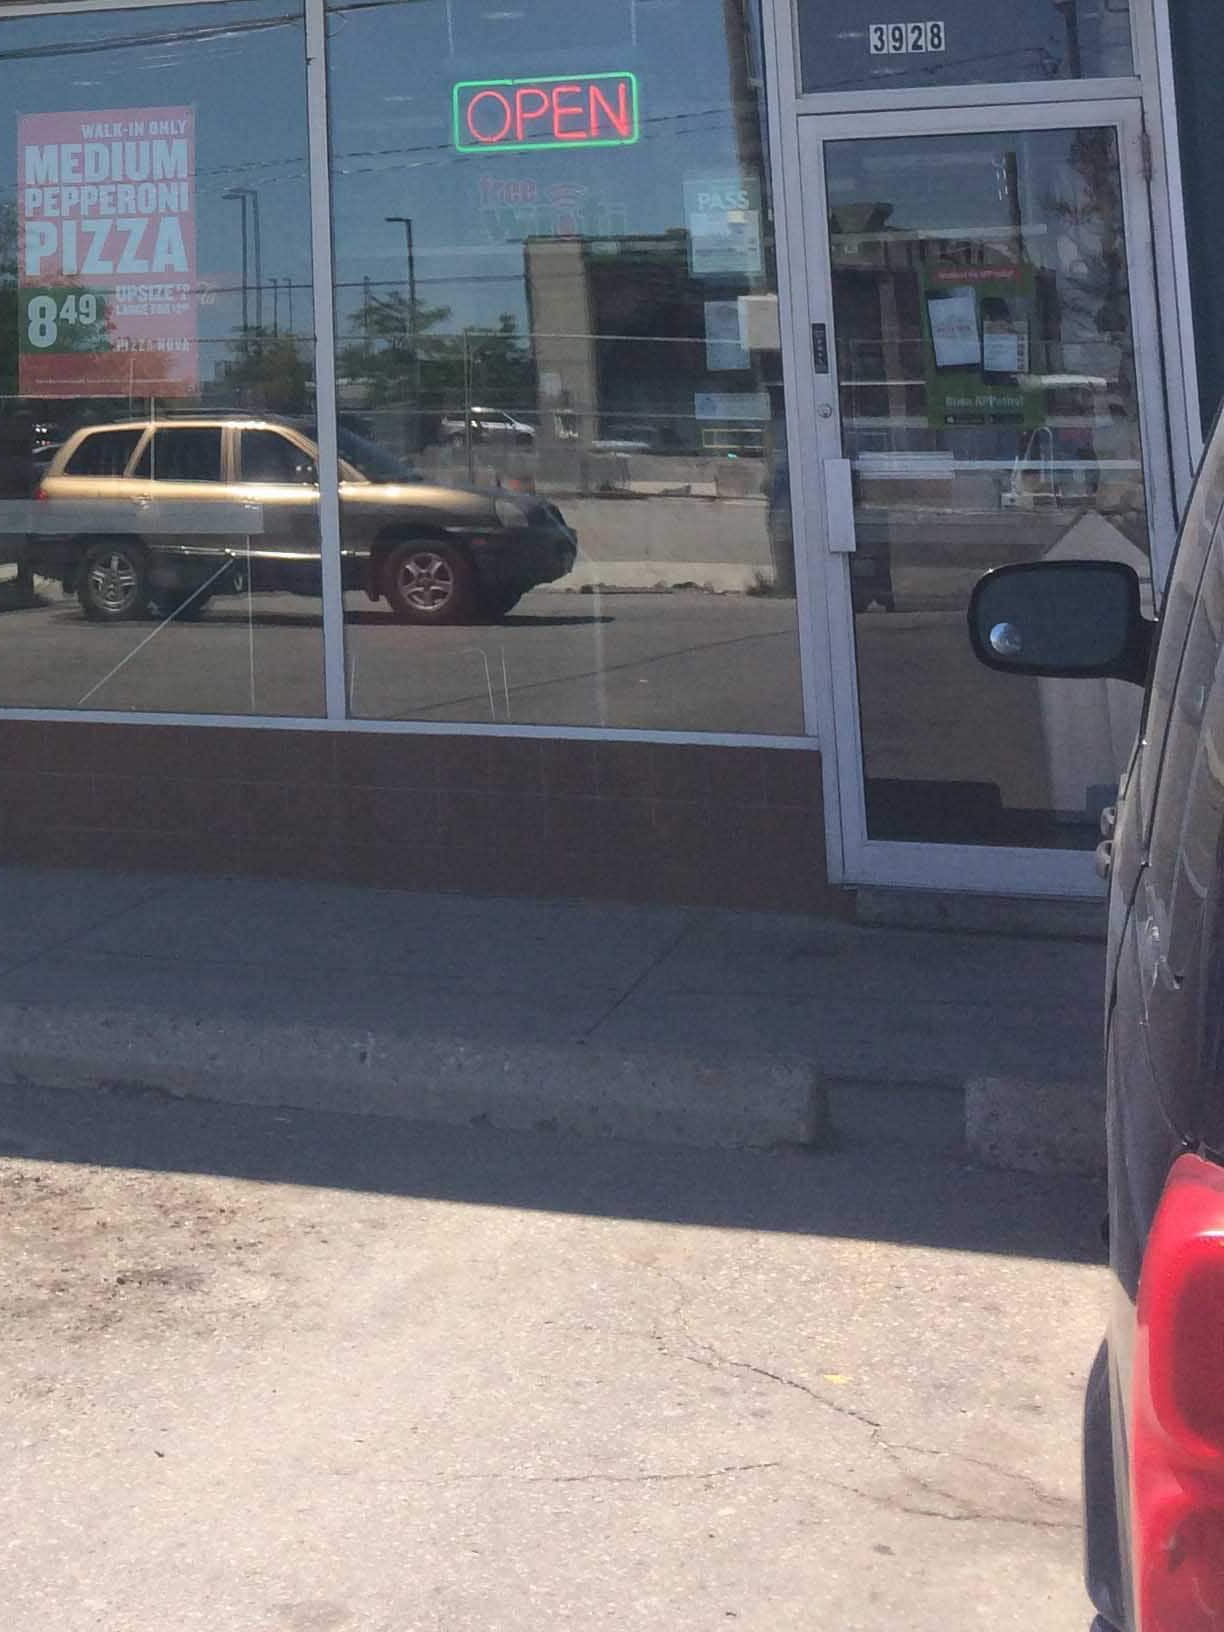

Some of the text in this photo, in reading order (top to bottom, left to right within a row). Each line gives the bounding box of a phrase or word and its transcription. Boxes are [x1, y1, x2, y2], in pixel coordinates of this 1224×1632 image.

[872, 23, 943, 53] 3928
[81, 120, 144, 139] WALK-IN
[466, 82, 632, 143] OPEN
[25, 139, 188, 185] MEDIUM
[25, 182, 189, 217] PEPPERONI
[696, 190, 749, 211] PASS
[25, 217, 188, 276] PIZZA
